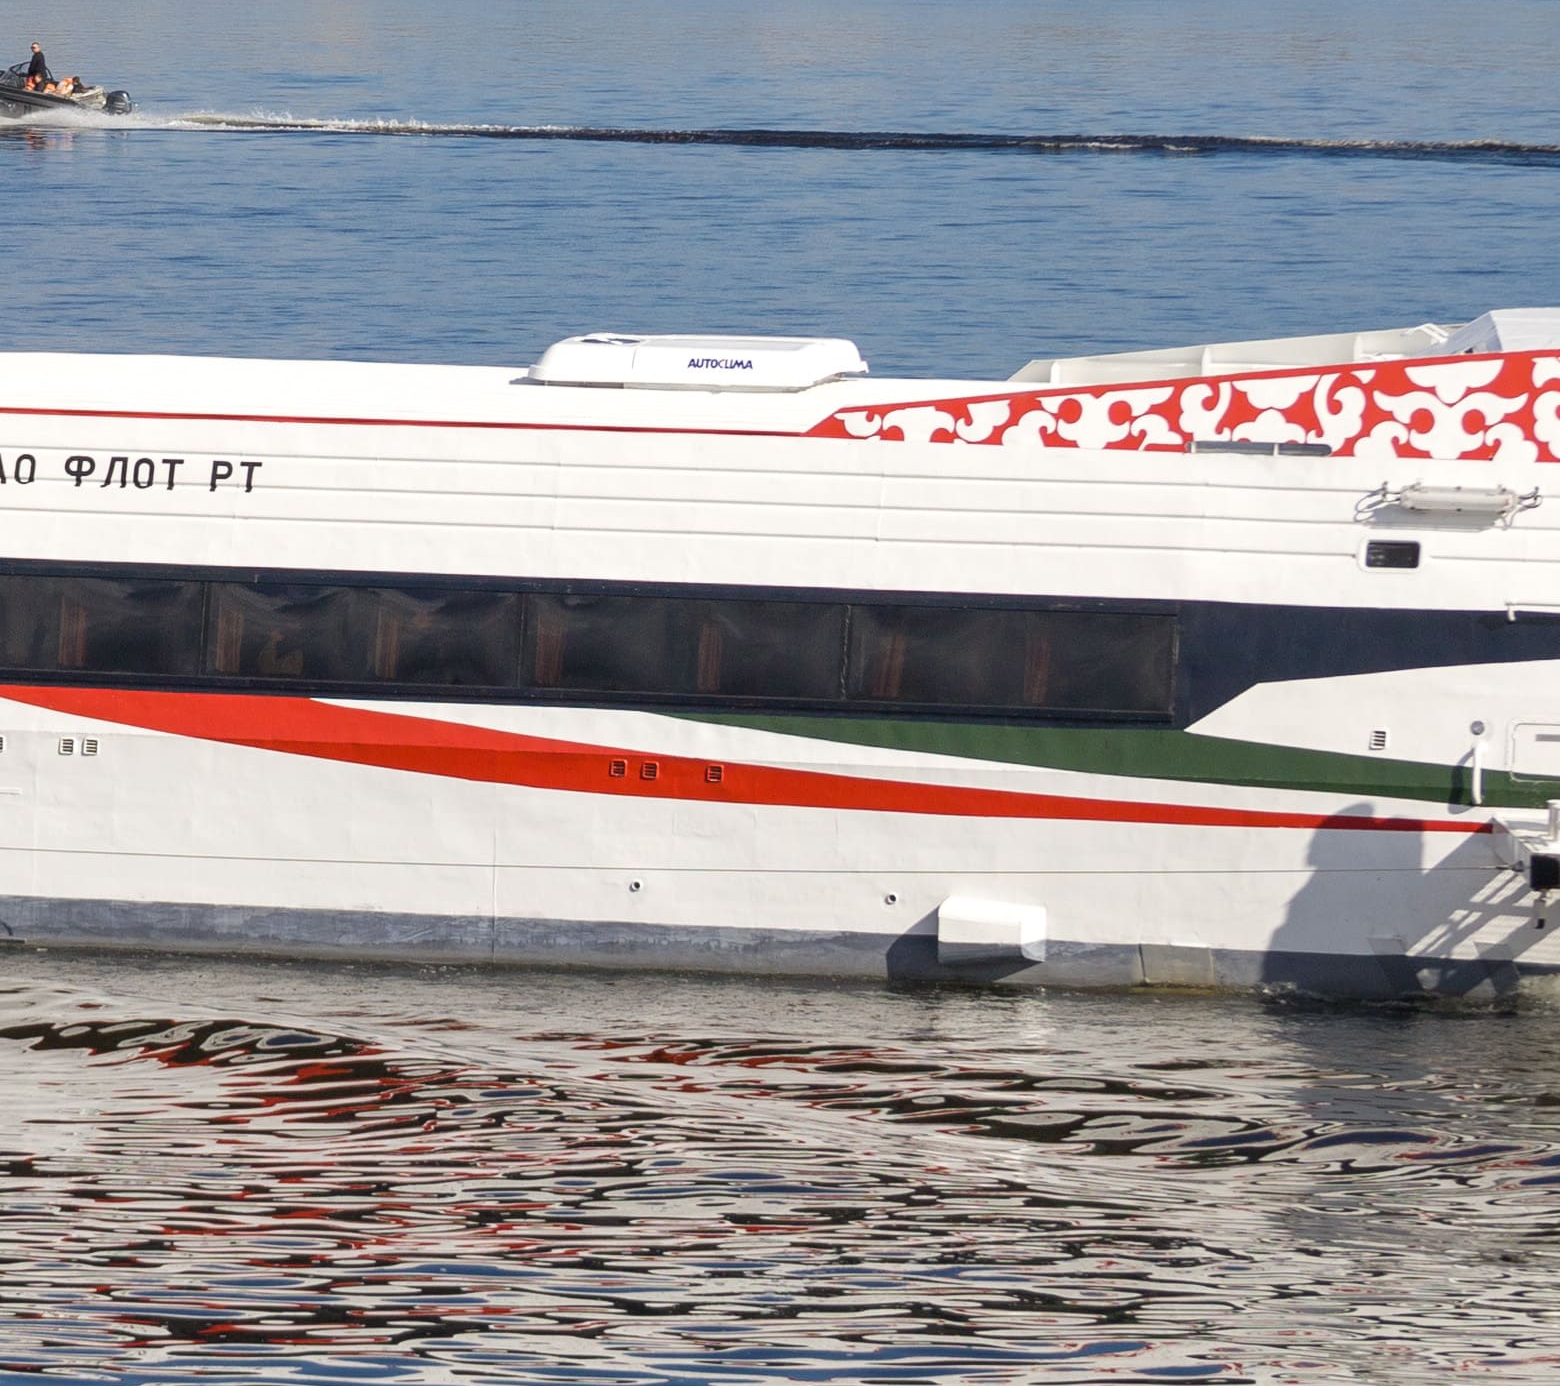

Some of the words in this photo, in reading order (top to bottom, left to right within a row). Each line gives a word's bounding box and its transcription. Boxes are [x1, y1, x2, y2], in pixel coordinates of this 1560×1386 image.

[687, 357, 753, 370] AUTOCLIMA
[63, 455, 185, 491] ФЛОТ
[209, 459, 264, 493] РТ
